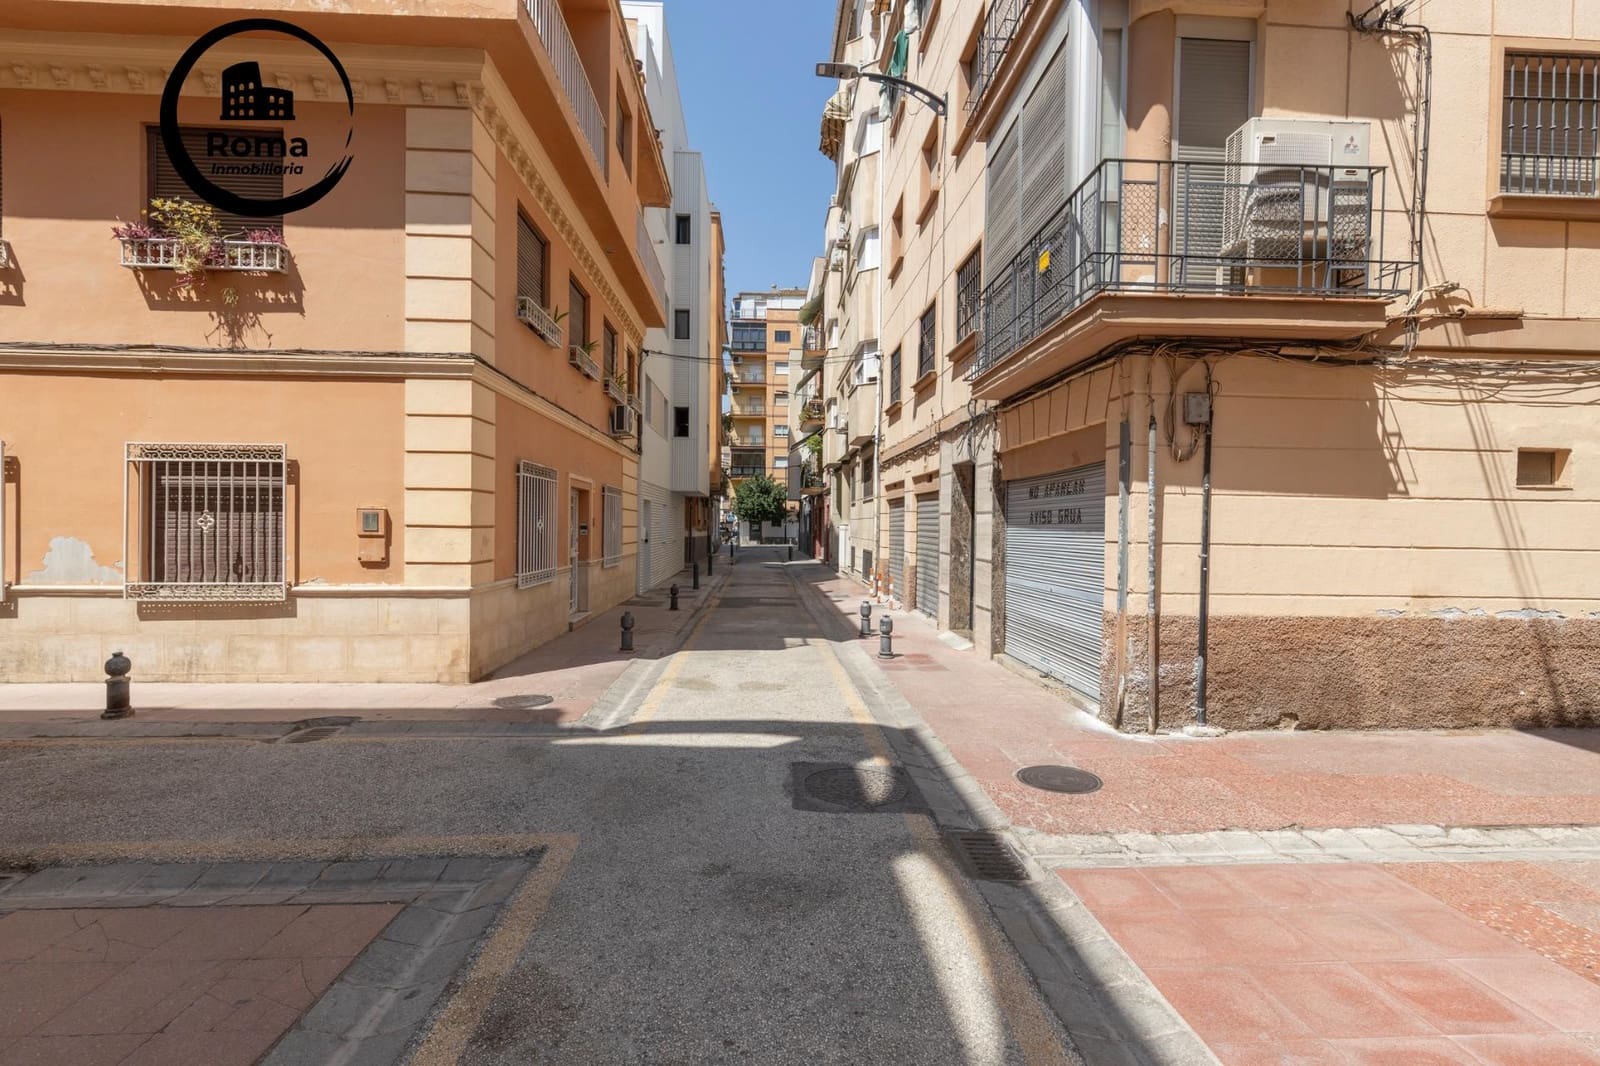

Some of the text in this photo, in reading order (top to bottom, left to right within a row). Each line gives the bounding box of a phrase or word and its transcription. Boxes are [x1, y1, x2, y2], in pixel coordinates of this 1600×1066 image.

[1029, 480, 1085, 499] NO APARCAR
[1029, 508, 1081, 525] AVISO GRUA
